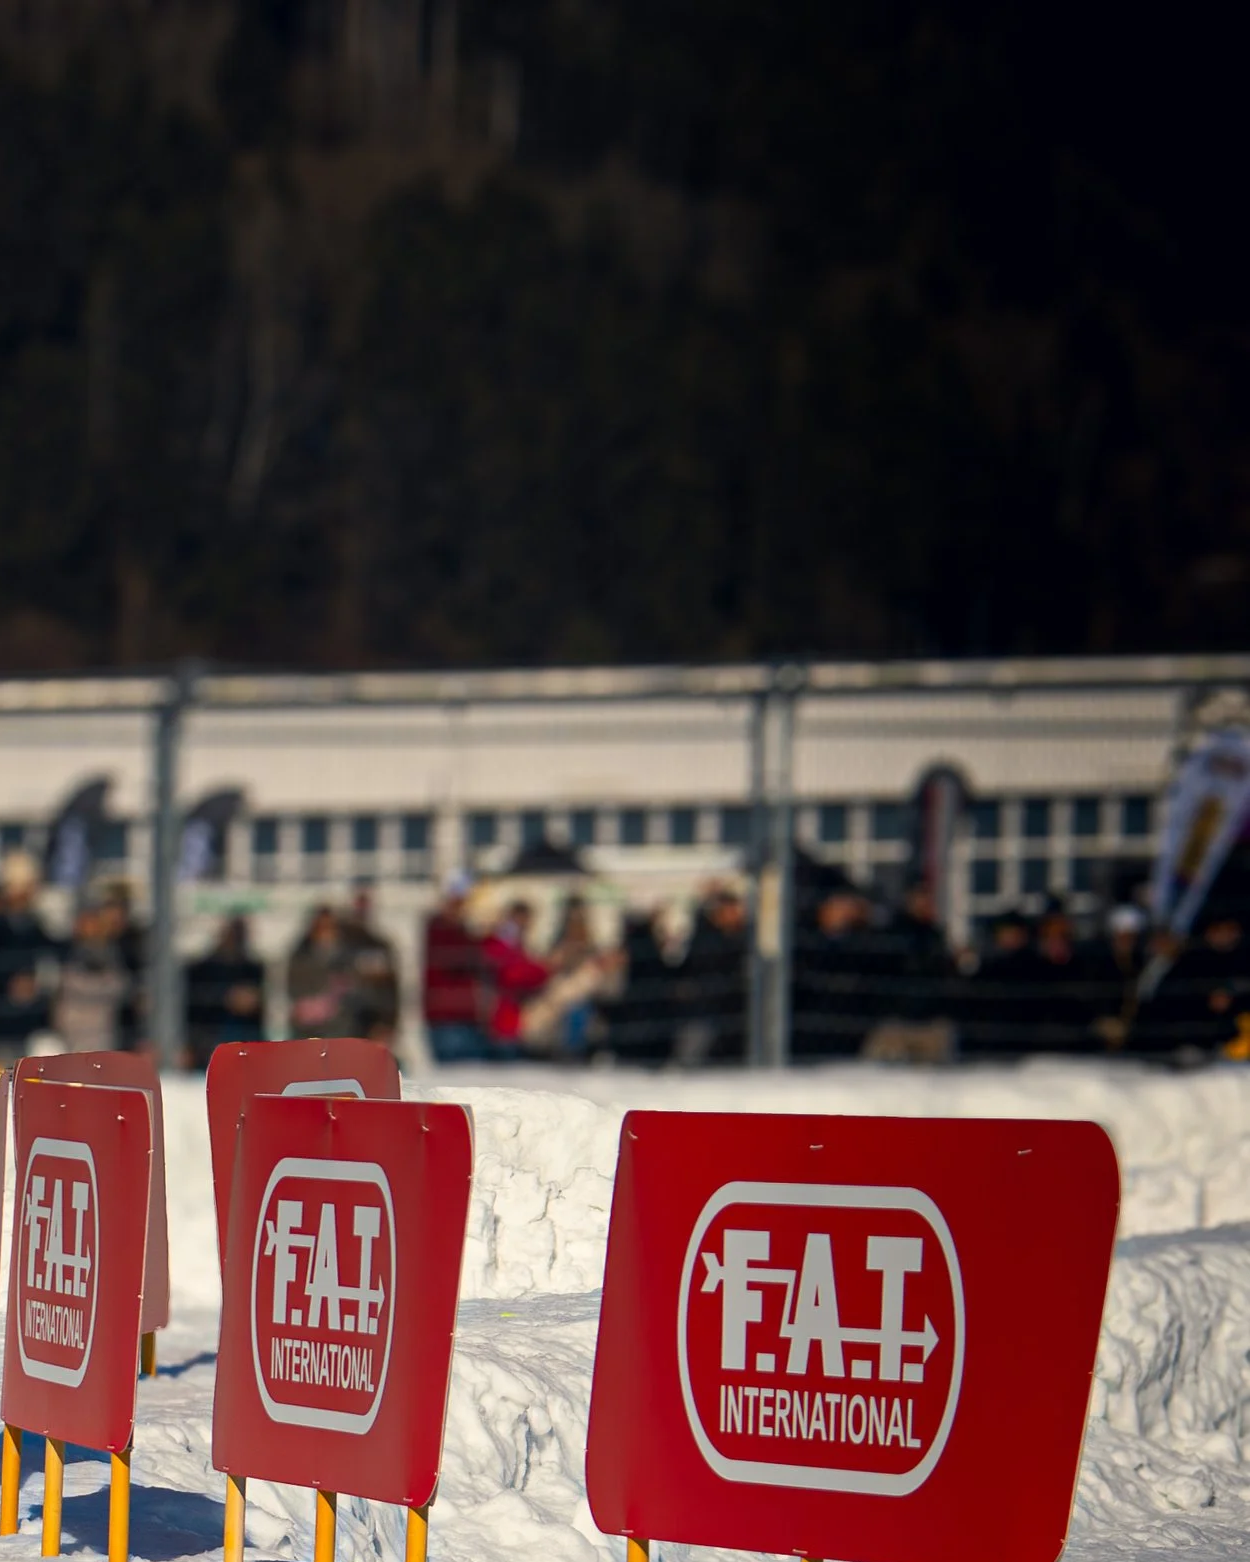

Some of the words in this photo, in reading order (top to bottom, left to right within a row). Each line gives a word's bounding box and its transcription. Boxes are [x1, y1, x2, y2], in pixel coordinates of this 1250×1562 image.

[25, 1298, 85, 1350] INTERNATIONAL
[270, 1337, 375, 1392] INTERNATIONAL
[719, 1384, 922, 1448] INTERNATIONAL
